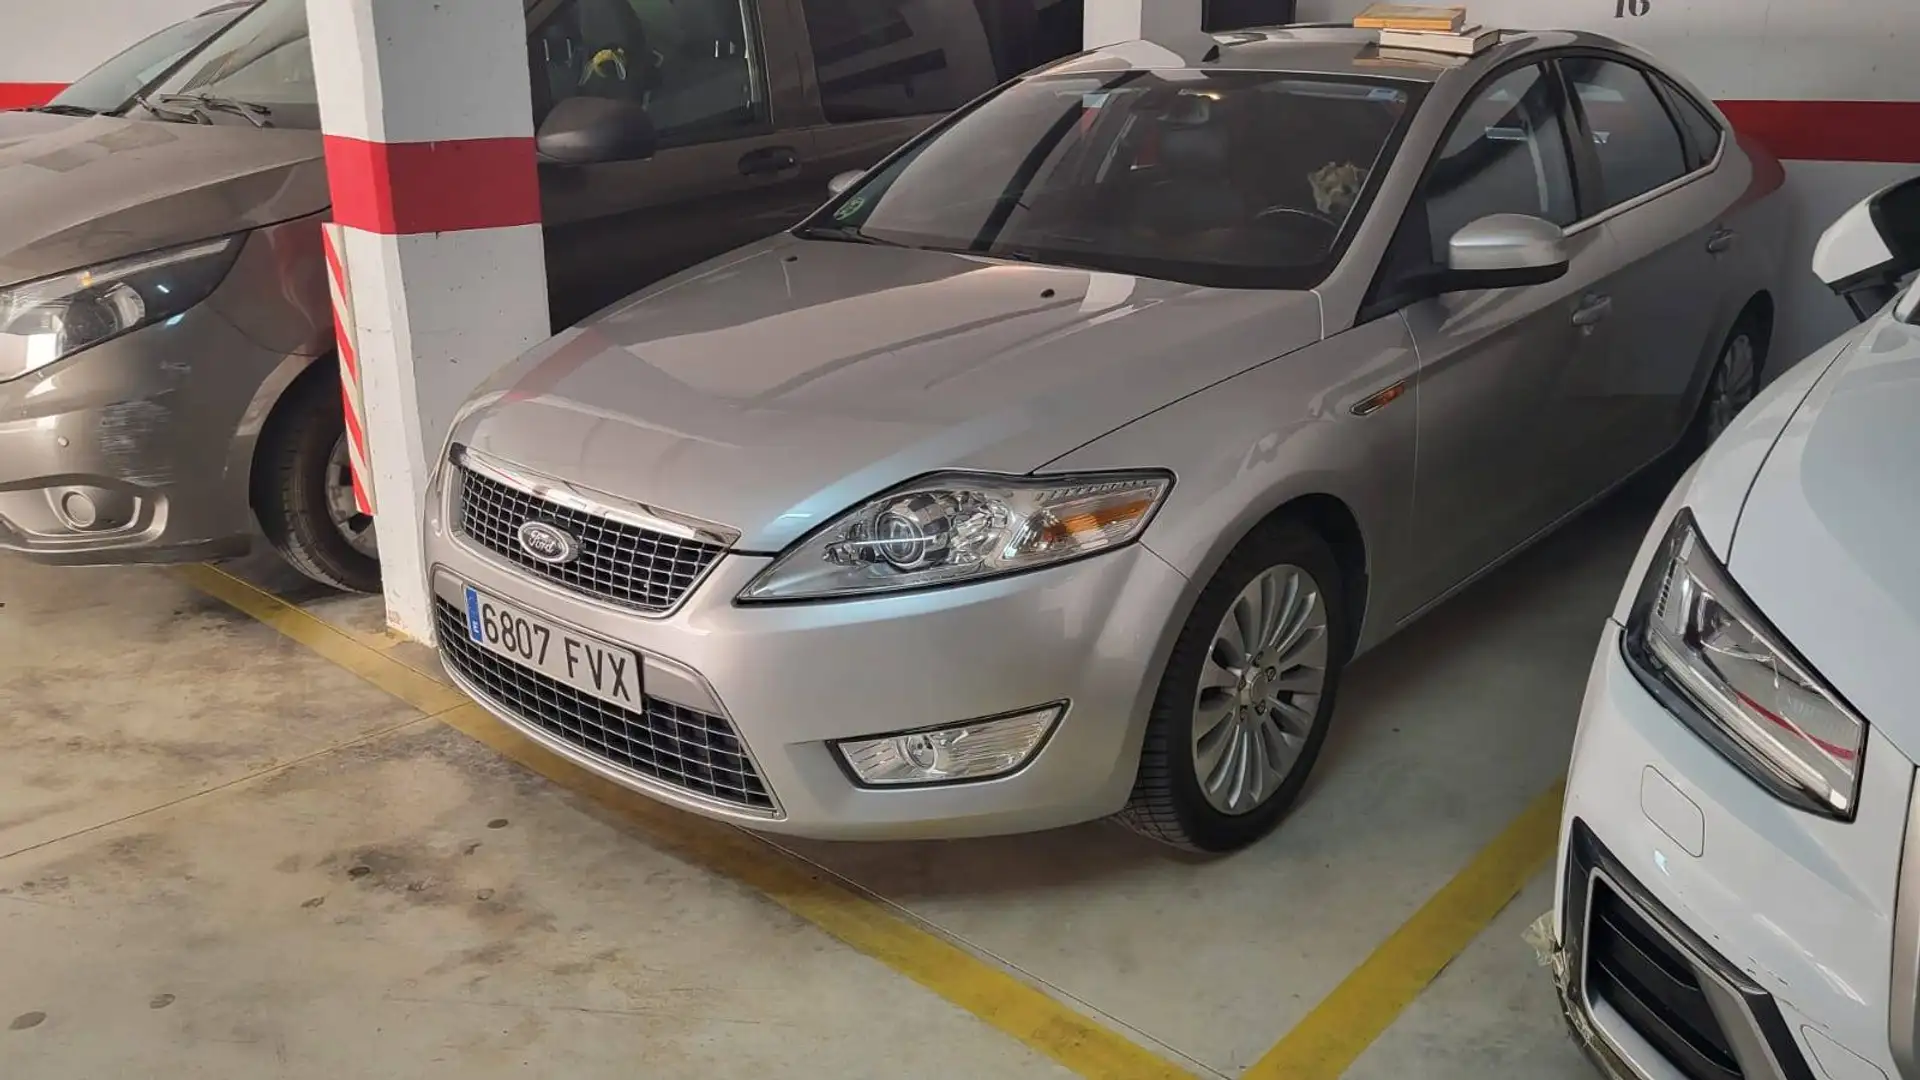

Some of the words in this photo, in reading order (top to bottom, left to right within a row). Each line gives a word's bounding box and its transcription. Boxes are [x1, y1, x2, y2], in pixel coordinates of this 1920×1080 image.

[529, 530, 557, 553] Ford
[482, 603, 550, 665] 6807
[564, 637, 630, 701] FVX
